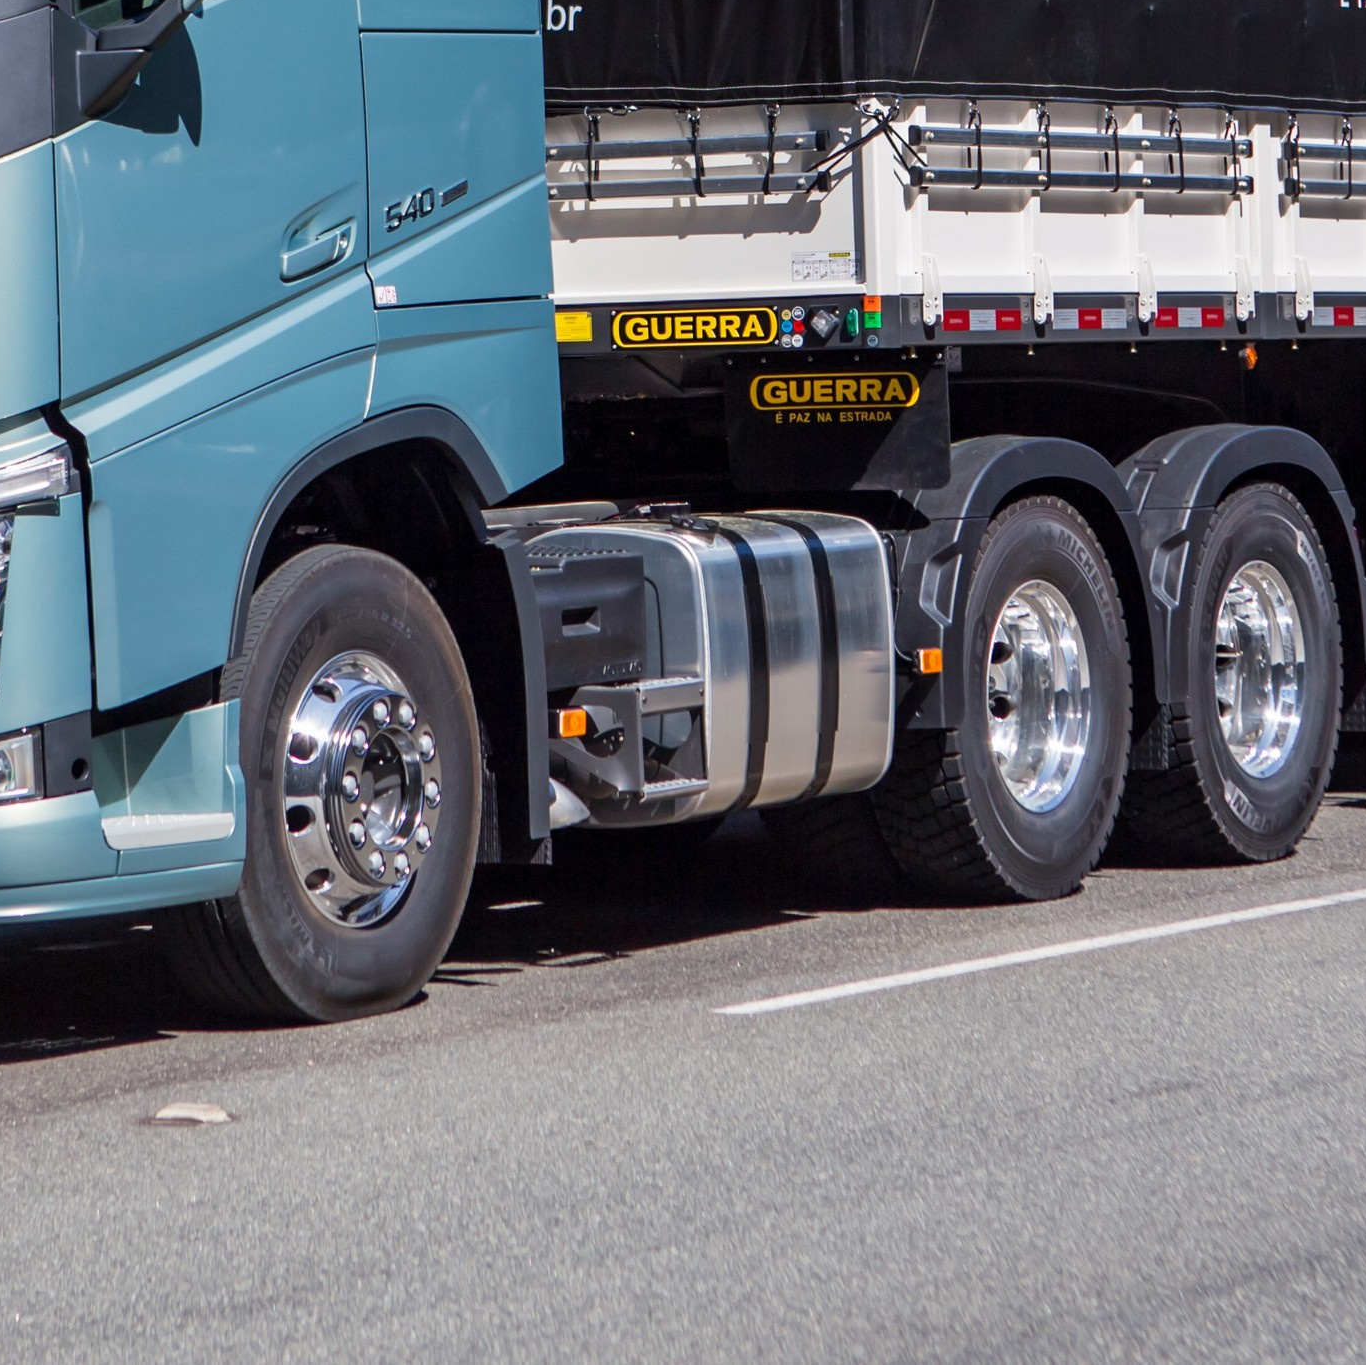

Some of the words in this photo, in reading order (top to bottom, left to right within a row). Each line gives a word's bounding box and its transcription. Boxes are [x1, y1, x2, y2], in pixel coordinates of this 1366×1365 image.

[384, 187, 435, 233] 540
[625, 314, 765, 342] GUERRA
[763, 378, 907, 404] GUERRA
[775, 411, 783, 423] É
[789, 412, 811, 423] PAZ
[817, 412, 833, 422] NA
[840, 411, 893, 423] ESTRADA
[1058, 528, 1116, 631] MICHELIN
